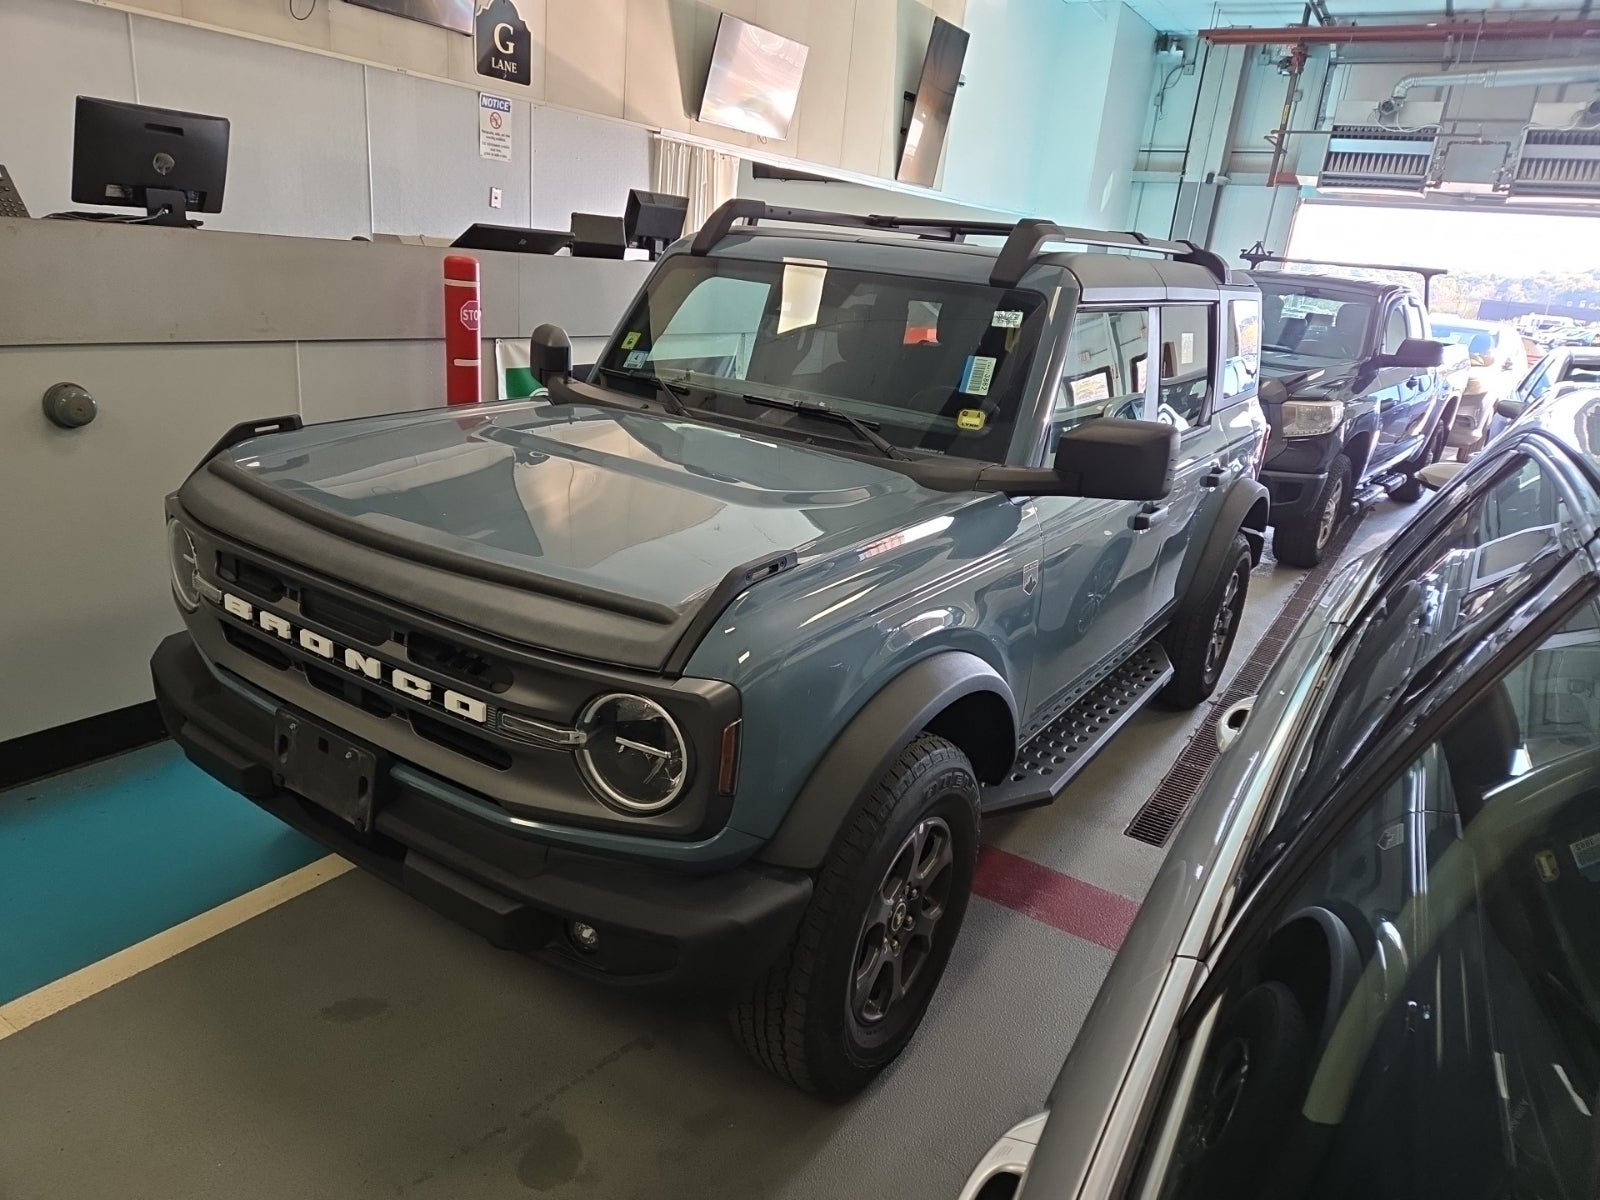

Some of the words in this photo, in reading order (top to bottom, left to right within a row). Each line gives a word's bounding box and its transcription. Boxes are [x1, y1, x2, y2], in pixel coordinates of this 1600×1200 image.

[493, 22, 515, 55] G
[491, 57, 518, 74] LANE
[481, 96, 511, 111] NOTICE
[224, 592, 487, 723] BRONCO
